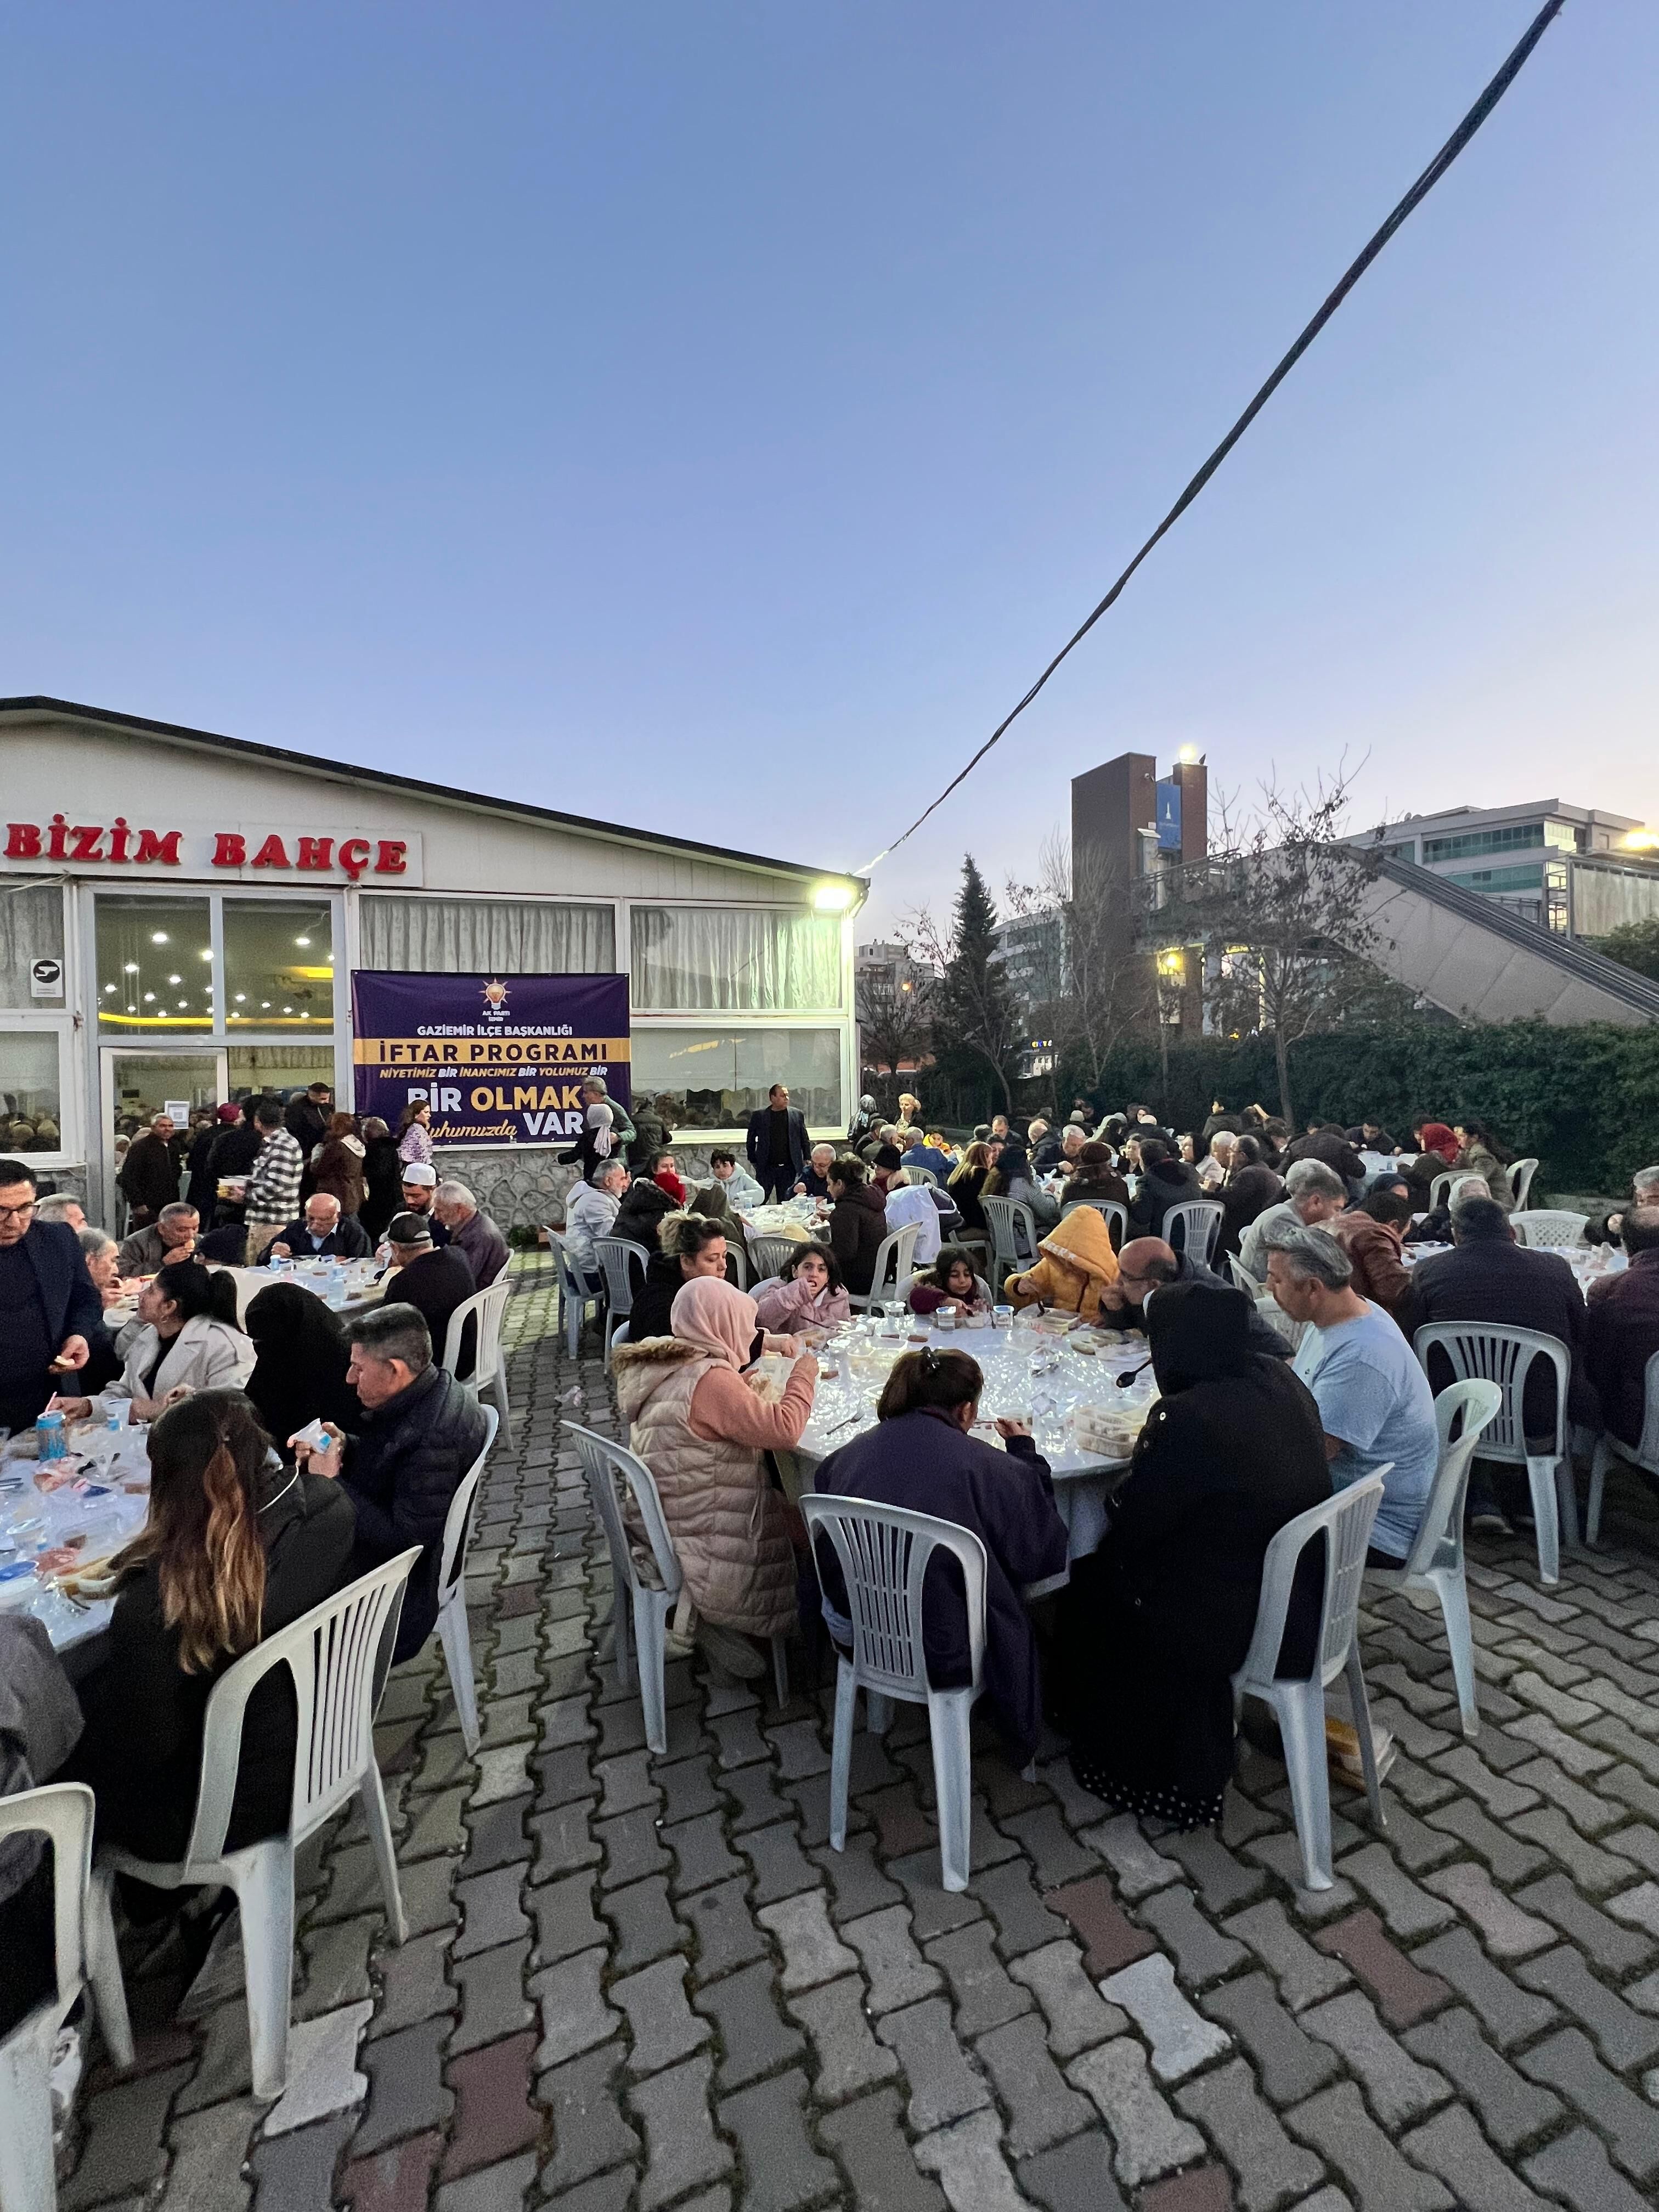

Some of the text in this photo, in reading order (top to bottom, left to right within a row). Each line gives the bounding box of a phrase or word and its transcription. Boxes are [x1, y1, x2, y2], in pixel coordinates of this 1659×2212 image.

[3, 814, 407, 880] BİZİM BAHÇE
[417, 1024, 572, 1037] GAZİEMİR İLÇE BAŞKANLIĞI
[380, 1041, 607, 1062] İFTAR PROGRAMI
[379, 1065, 608, 1078] NİYETİMİZ BİR İNANCIMIZ BİR YOLUMUZ BİR
[471, 1085, 583, 1111] OLMAK
[430, 1111, 584, 1138] uhumuzda VAR
